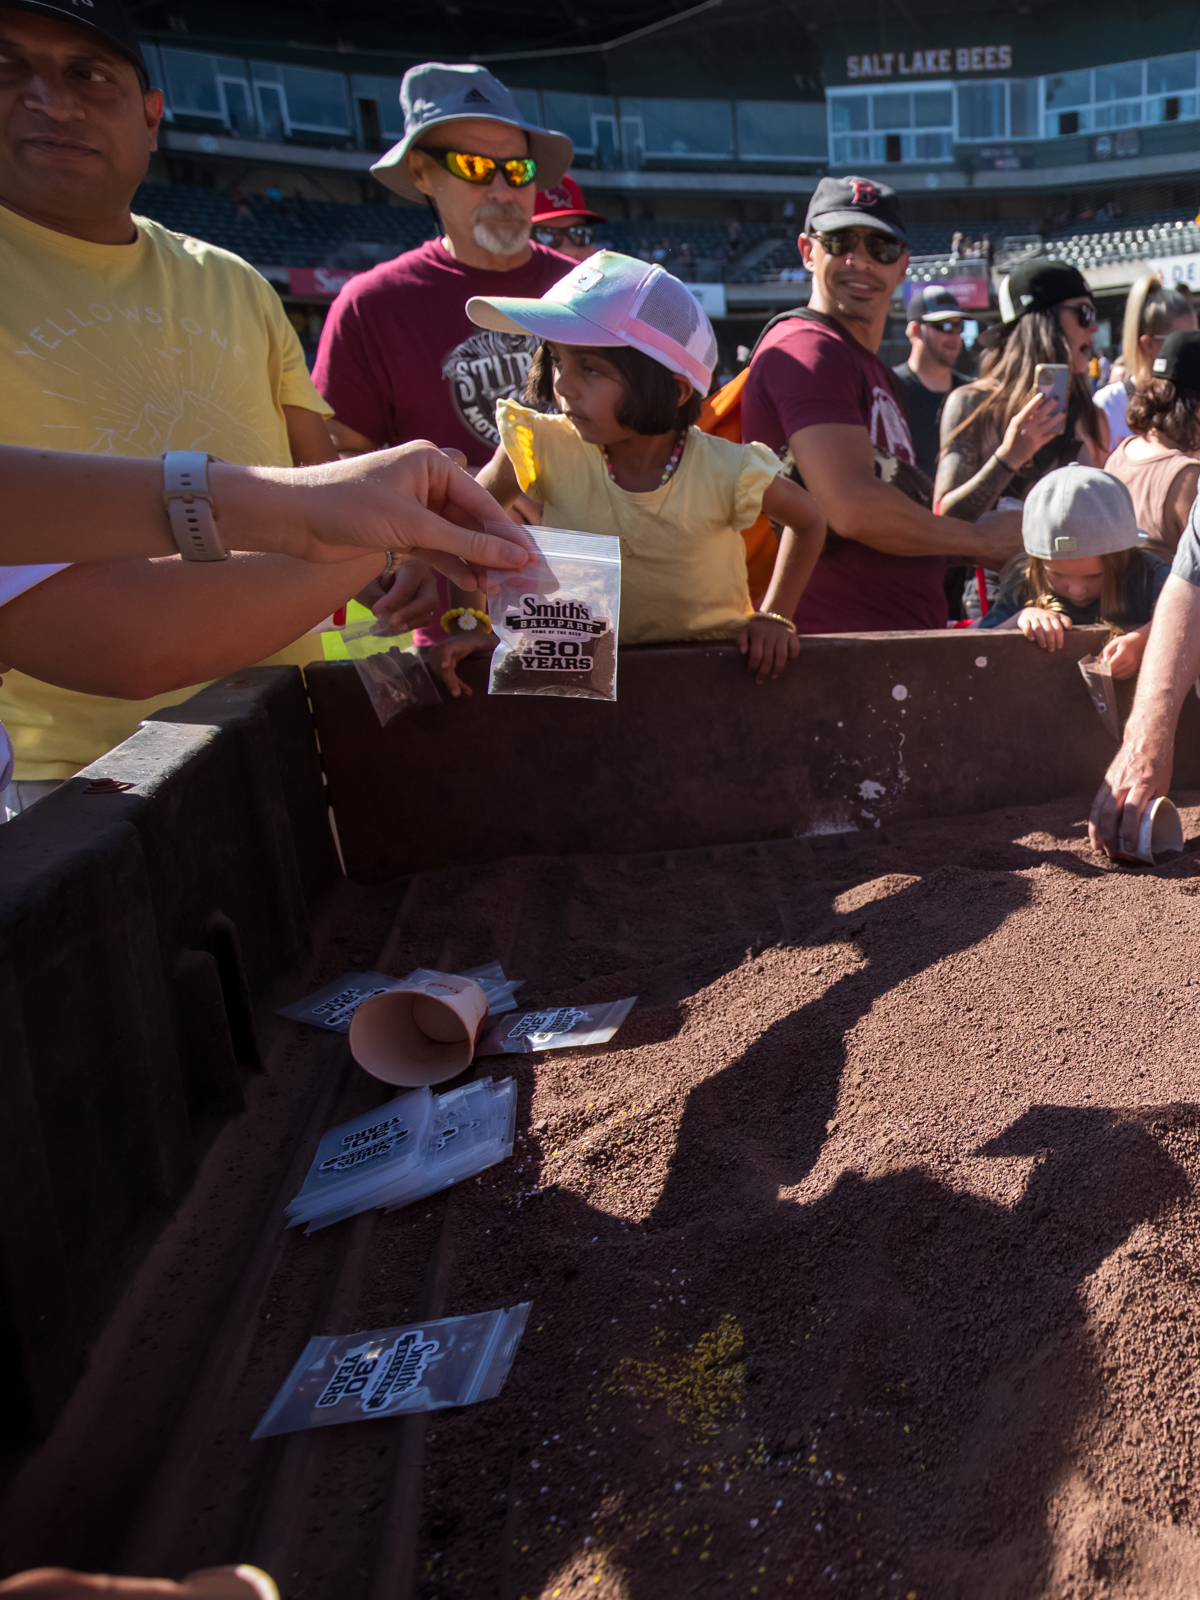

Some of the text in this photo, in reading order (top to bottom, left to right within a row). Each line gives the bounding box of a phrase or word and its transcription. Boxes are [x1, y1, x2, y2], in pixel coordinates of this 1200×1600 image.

[847, 45, 1012, 78] SALT LAKE BEES
[522, 597, 590, 621] Smith's
[520, 619, 594, 633] BALLPARK
[534, 640, 580, 657] 30
[521, 656, 591, 670] YEARS
[343, 1116, 401, 1143] YEARS
[351, 1127, 391, 1148] 30
[318, 1353, 363, 1406] YEARS
[343, 1358, 379, 1394] 30
[391, 1343, 435, 1395] Smith's
